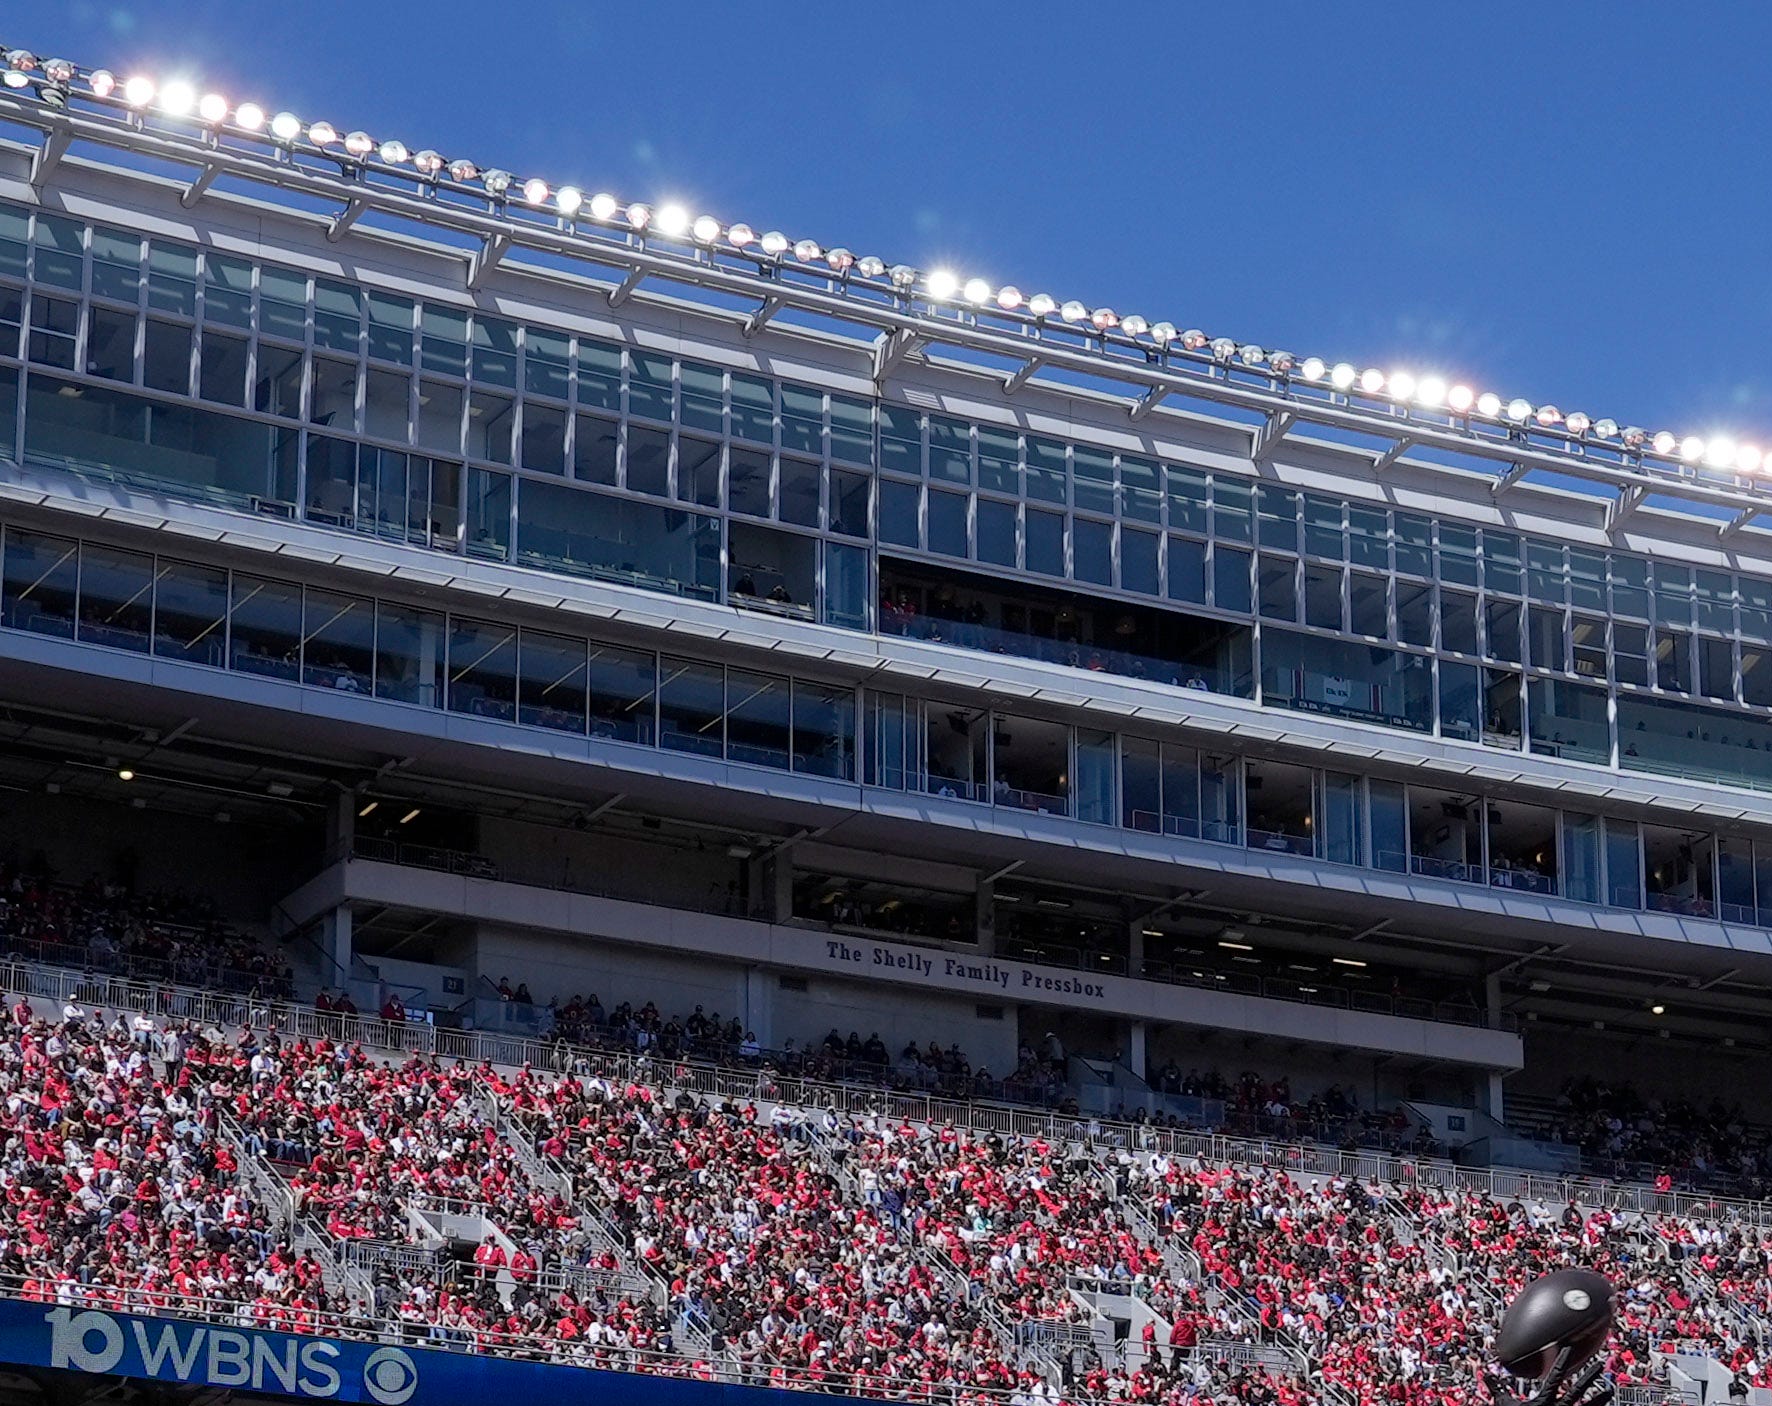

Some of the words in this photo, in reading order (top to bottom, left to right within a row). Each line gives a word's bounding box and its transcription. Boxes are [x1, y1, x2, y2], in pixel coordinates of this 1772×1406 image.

[827, 941, 862, 961] The
[873, 947, 932, 976] Shelly
[945, 959, 1010, 988] Family
[1022, 970, 1105, 998] Pressbox
[45, 1306, 124, 1373] 10
[132, 1319, 341, 1398] WBNS
